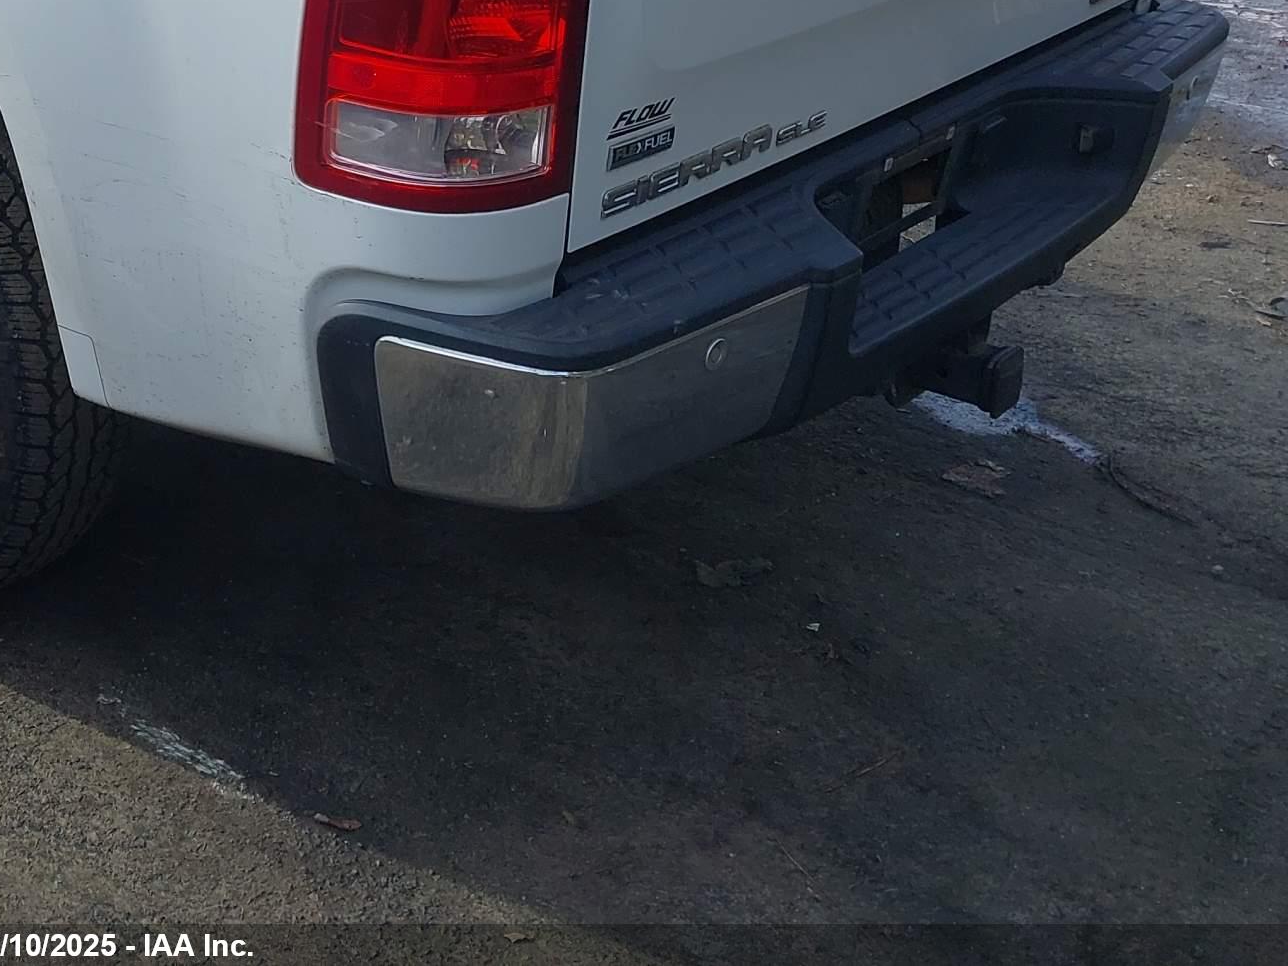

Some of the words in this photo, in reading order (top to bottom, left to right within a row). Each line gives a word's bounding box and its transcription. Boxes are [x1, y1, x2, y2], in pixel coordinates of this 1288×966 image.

[612, 98, 675, 129] FLOW
[600, 124, 773, 219] SIERRA
[776, 110, 828, 146] SLE
